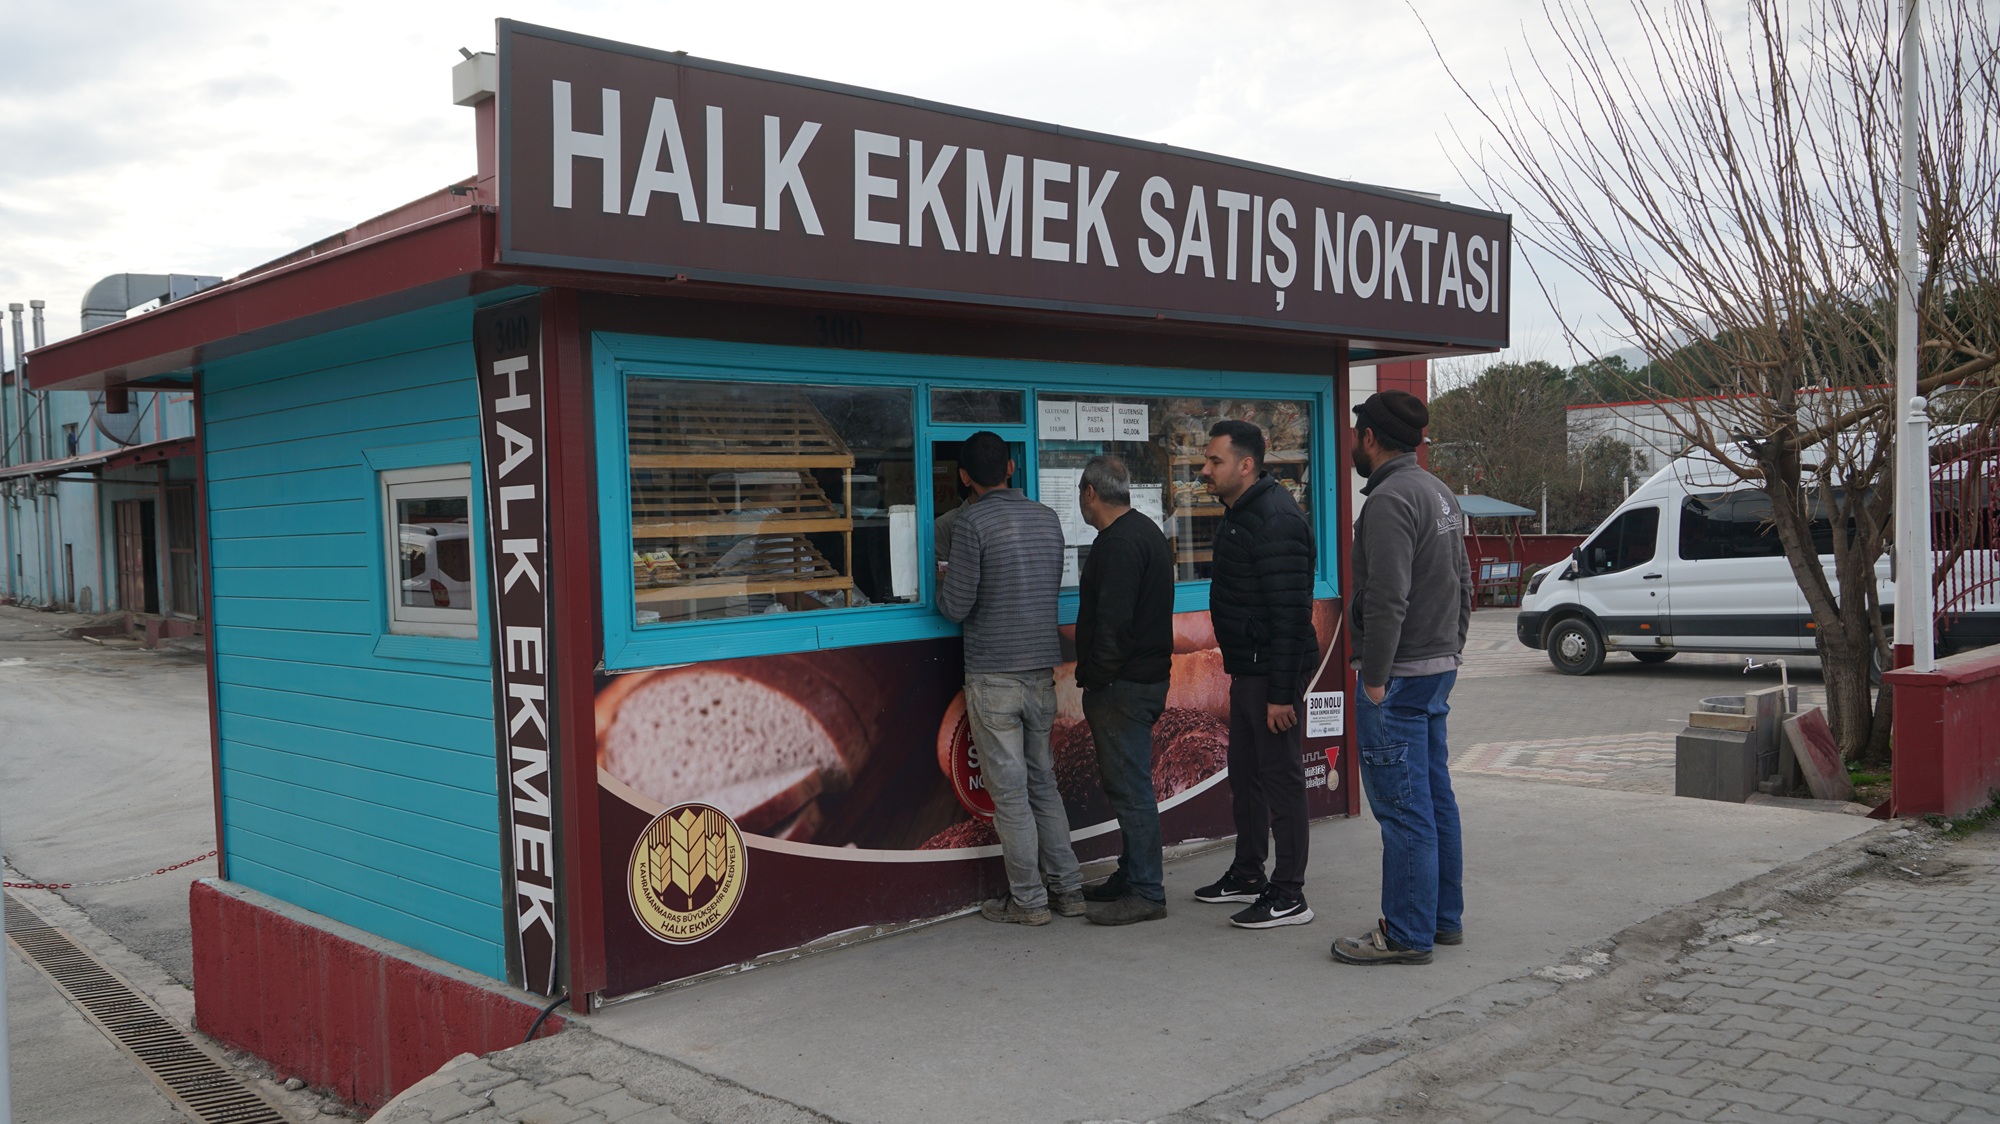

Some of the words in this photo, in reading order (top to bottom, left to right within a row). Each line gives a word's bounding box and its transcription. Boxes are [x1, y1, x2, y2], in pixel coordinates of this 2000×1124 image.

[552, 79, 825, 236] HALK
[854, 129, 1120, 267] EKMEK
[1137, 175, 1297, 311] SATIŞ
[1313, 207, 1499, 314] NOKTASI
[495, 314, 529, 354] 300
[815, 314, 863, 346] 300
[493, 355, 540, 595] HALK
[1310, 697, 1323, 709] 300
[1324, 696, 1341, 708] NOLU
[506, 626, 554, 941] EKMEK
[639, 862, 682, 923] KAHRAMANMARAŞ
[682, 893, 725, 923] BÜYÜKŞEHİR
[722, 845, 736, 895] BELEDİYESİ
[660, 920, 687, 934] HALK
[689, 909, 722, 934] EKMEK
